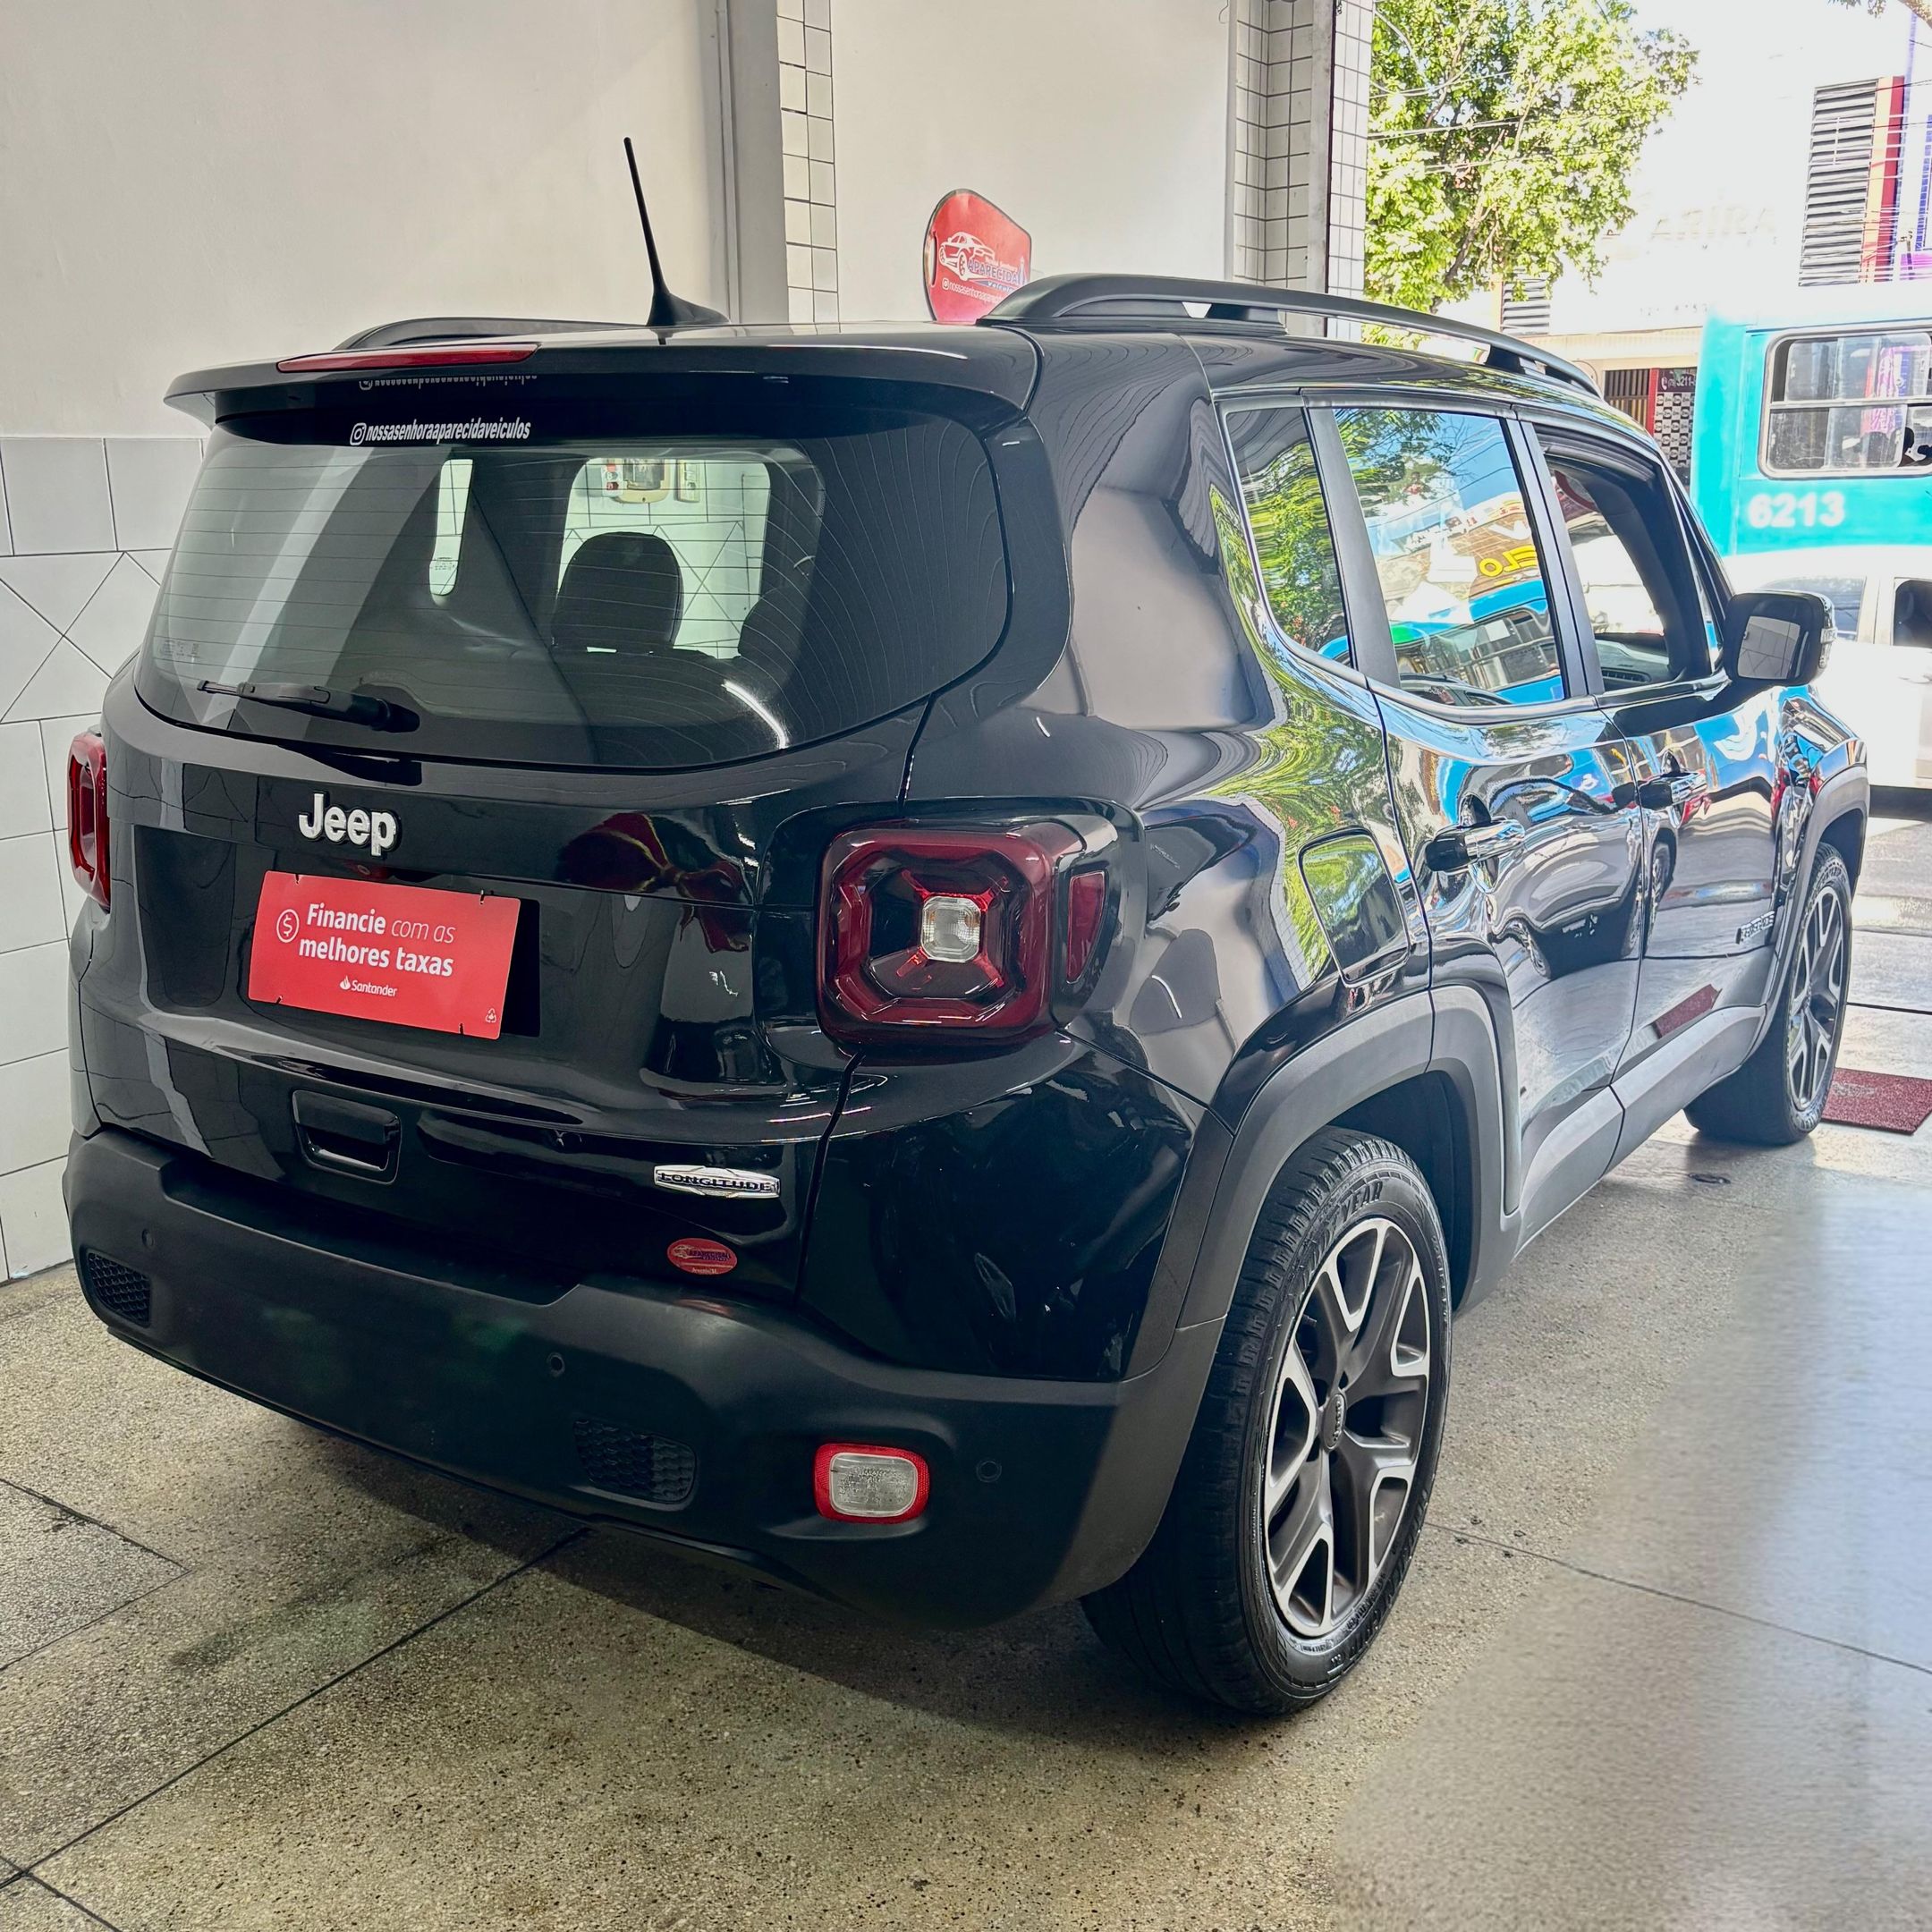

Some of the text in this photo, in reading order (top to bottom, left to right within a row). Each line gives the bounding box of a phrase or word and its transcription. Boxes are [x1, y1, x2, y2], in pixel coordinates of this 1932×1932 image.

[967, 258, 1020, 284] APARECIDA
[365, 417, 532, 445] nossasenhoraaparecidaveiculos
[1749, 492, 1845, 529] 6213
[298, 792, 398, 857] Jeep
[307, 903, 456, 944] Financie com as
[299, 936, 454, 977] melhores taxas
[352, 979, 398, 997] Santander
[657, 1173, 772, 1192] LONGITUDE
